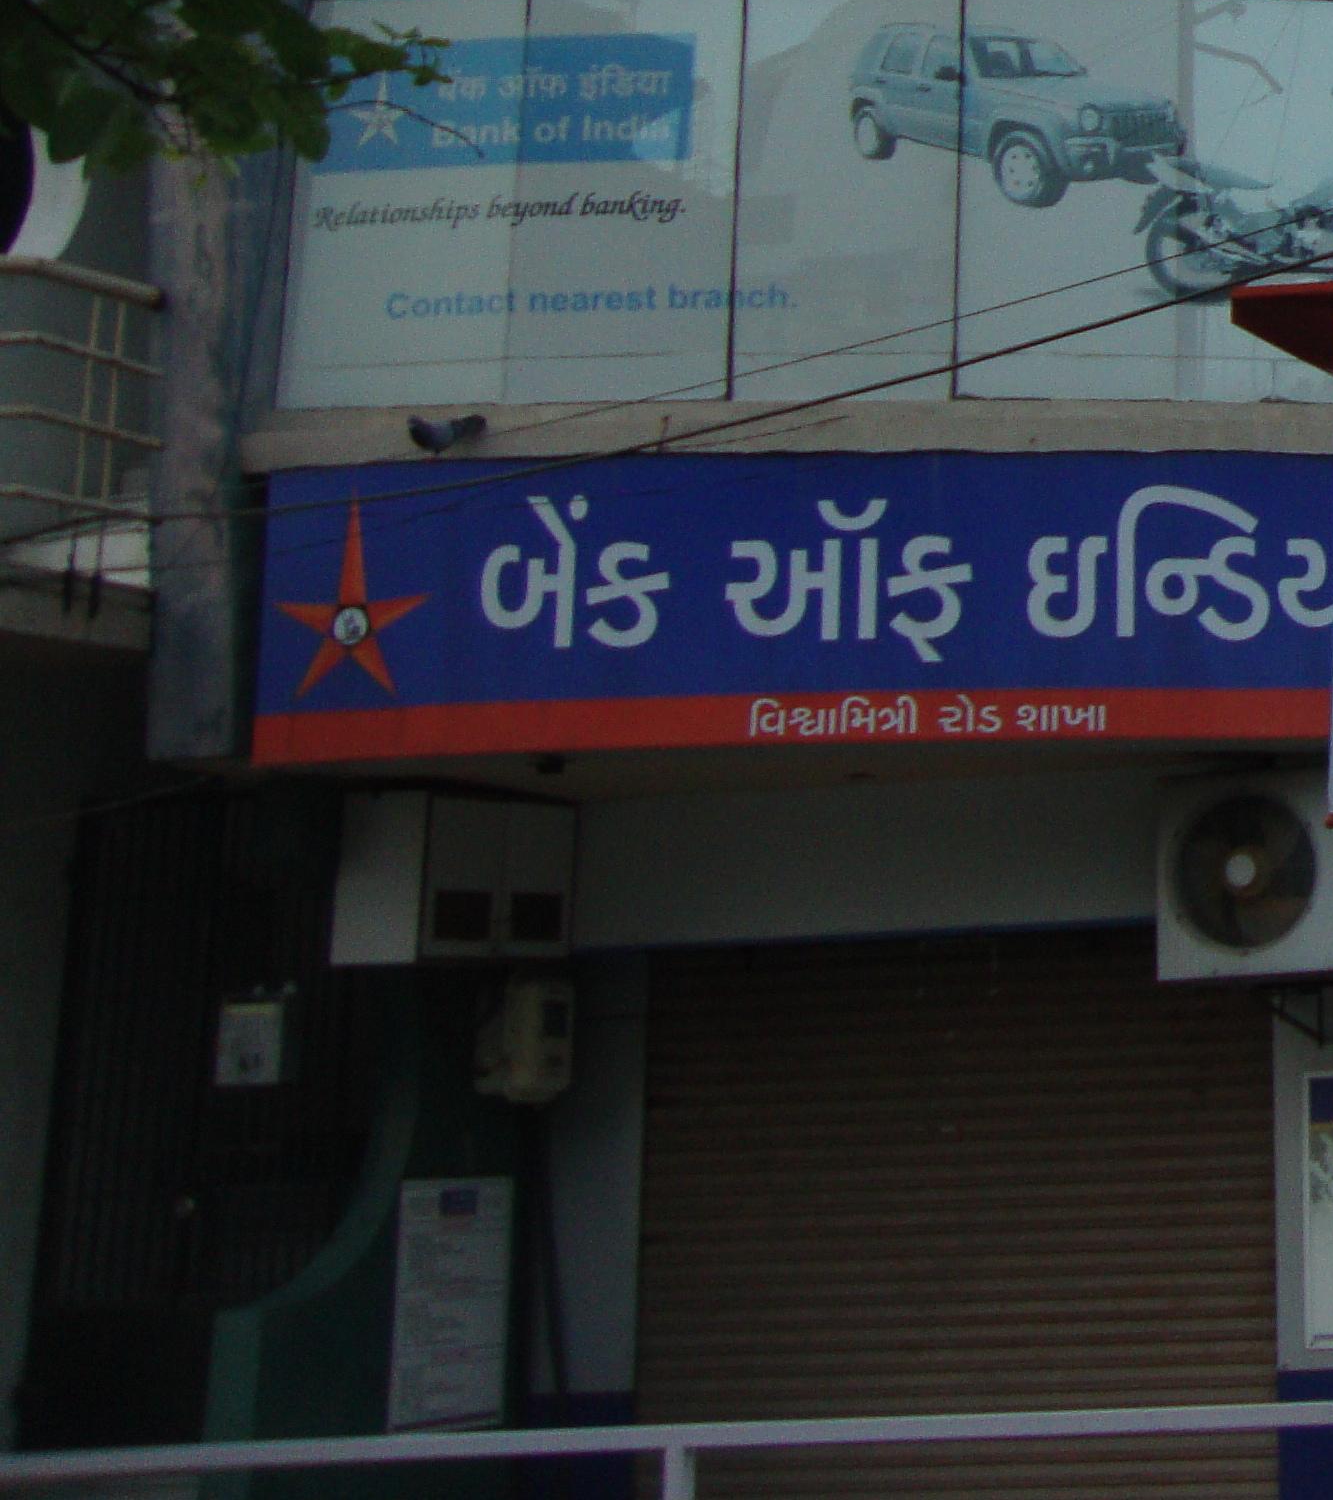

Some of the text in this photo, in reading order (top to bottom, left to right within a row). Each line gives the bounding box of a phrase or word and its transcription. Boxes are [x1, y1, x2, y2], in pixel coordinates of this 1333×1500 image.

[431, 111, 521, 150] Bank
[534, 113, 571, 146] of
[313, 190, 688, 233] Relationships beyond banking.
[386, 288, 517, 321] Contact
[527, 284, 657, 315] nearest
[481, 493, 669, 648] બેંક
[724, 498, 972, 663] ઑફ
[937, 694, 1002, 733] રોડ
[1016, 704, 1106, 733] શાખા
